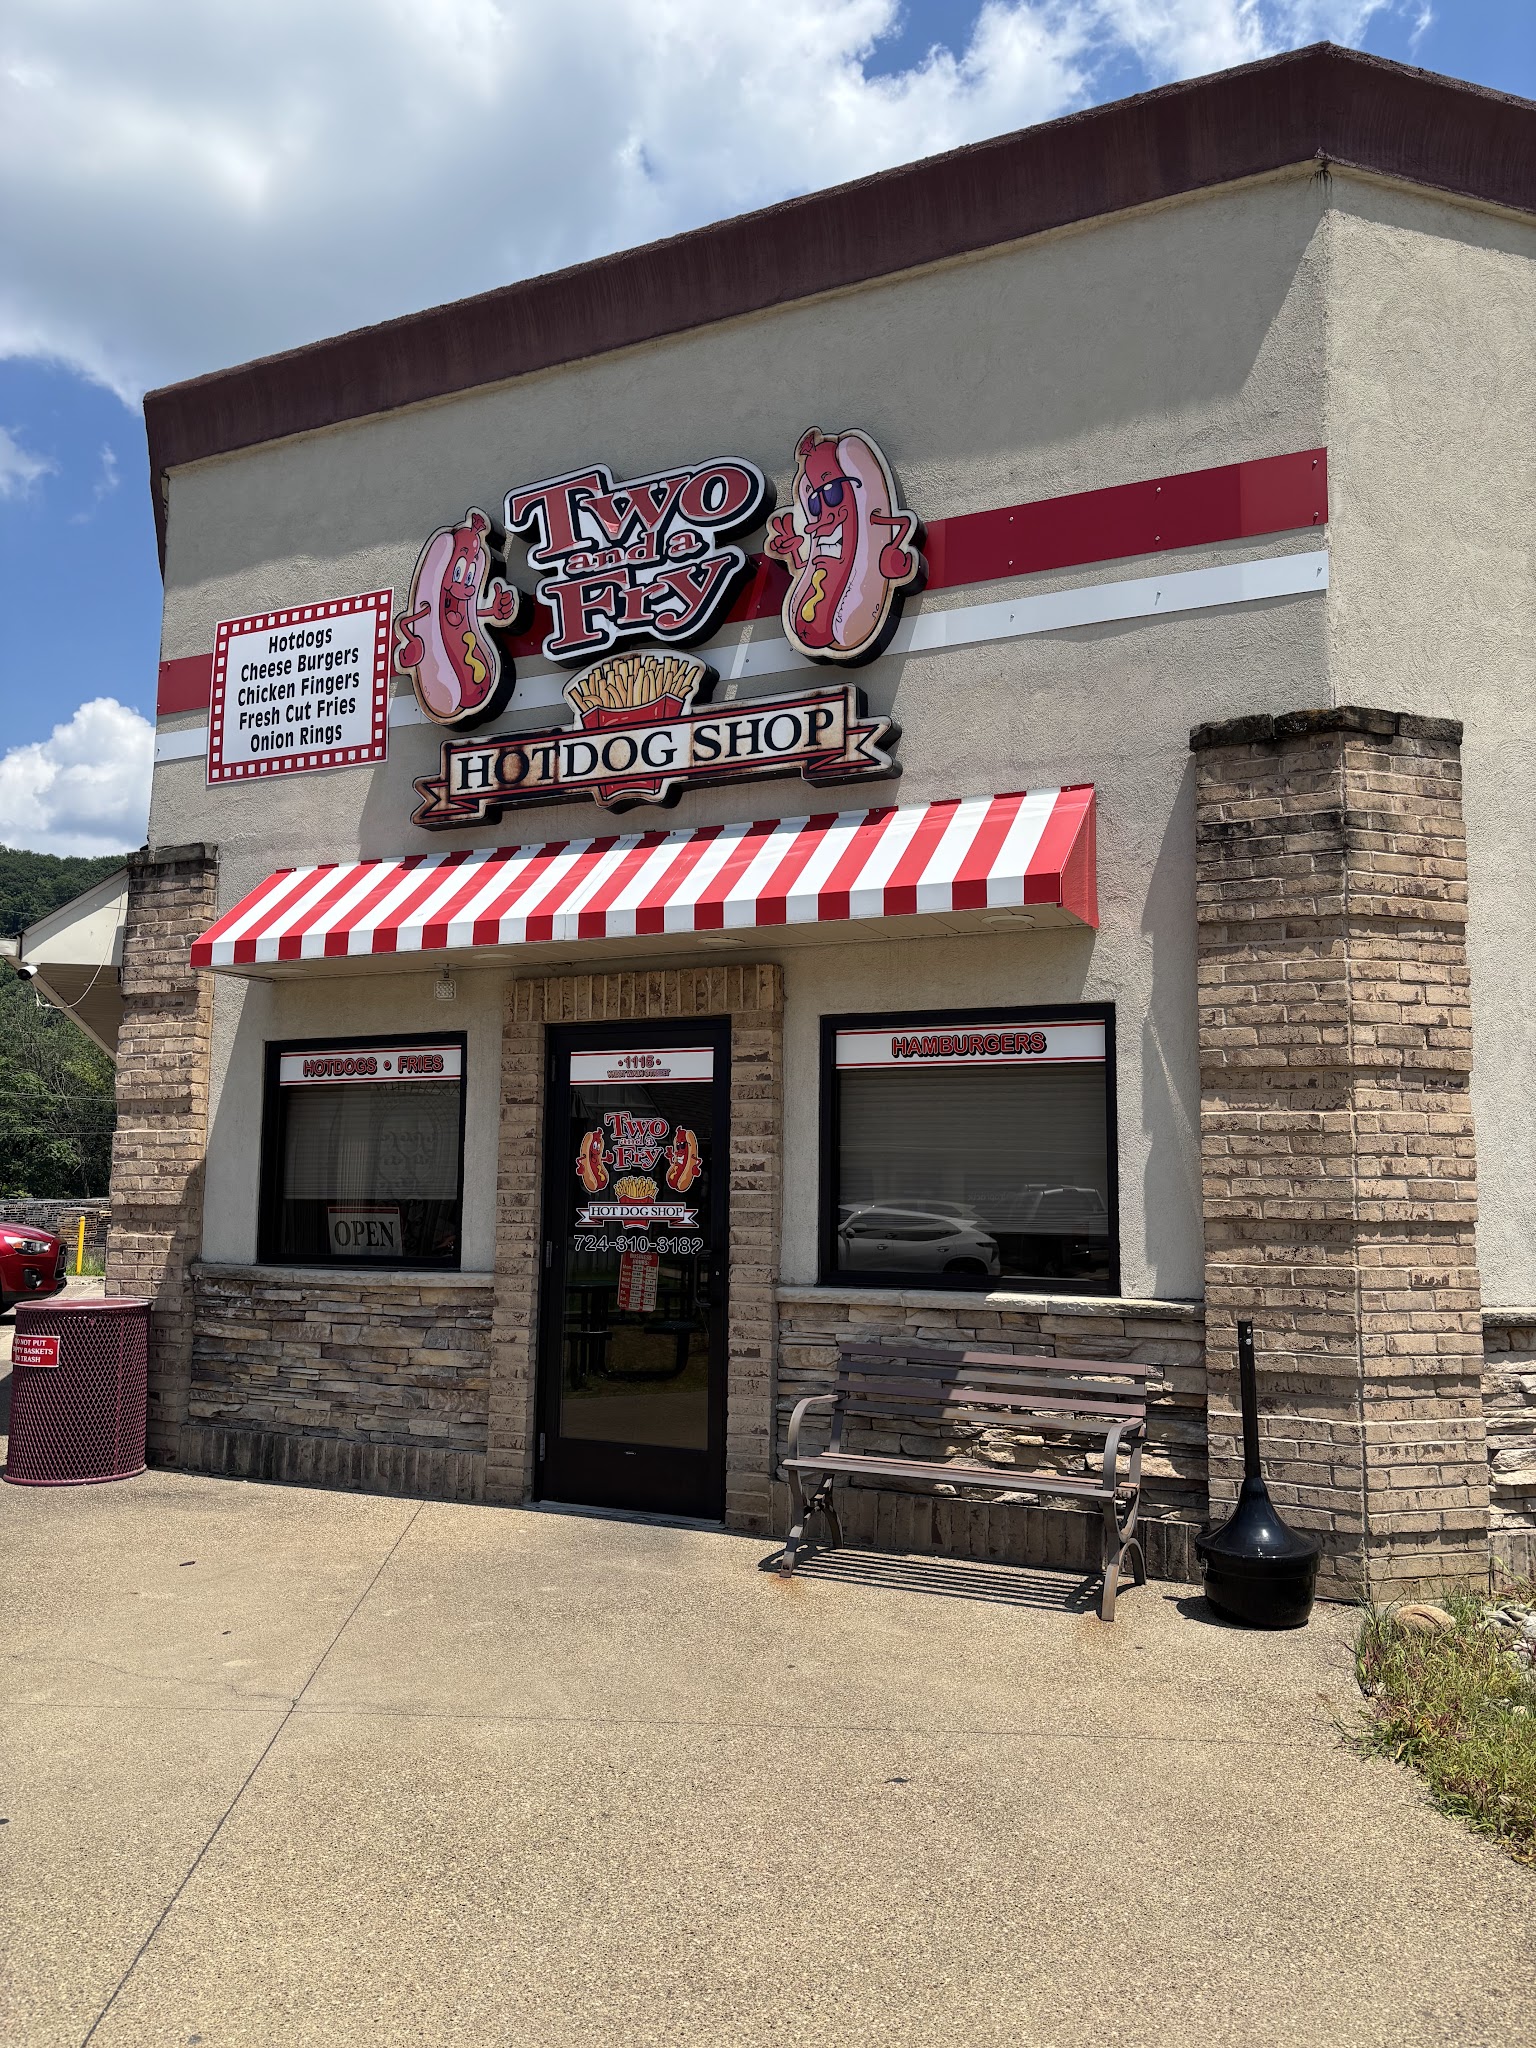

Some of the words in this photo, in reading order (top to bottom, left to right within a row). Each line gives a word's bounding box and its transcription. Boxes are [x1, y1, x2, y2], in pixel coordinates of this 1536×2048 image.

[511, 464, 752, 560] Two
[567, 530, 661, 574] and
[668, 528, 703, 559] a
[545, 553, 732, 651] Fry
[268, 627, 333, 654] Hotdogs
[240, 659, 293, 683] Cheese
[297, 646, 360, 673] Burgers
[237, 681, 296, 707] Chicken
[301, 671, 360, 697] Fingers
[239, 705, 281, 731] Fresh
[285, 700, 312, 724] Cut
[317, 695, 357, 719] Fries
[250, 725, 295, 753] Onion
[299, 723, 343, 748] Rings
[456, 730, 680, 791] HOTDOG
[692, 707, 835, 764] SHOP
[892, 1032, 1047, 1058] HAMBURGERS
[303, 1057, 378, 1077] HOTDOGS
[397, 1054, 444, 1074] FRIES
[604, 1112, 668, 1138] Two
[619, 1136, 645, 1147] and
[645, 1137, 656, 1147] a
[614, 1146, 664, 1170] Fry
[590, 1206, 618, 1217] HOT
[620, 1206, 649, 1217] DOG
[650, 1206, 683, 1217] SHOP
[334, 1220, 395, 1248] OPEN
[573, 1234, 704, 1255] 724-310-3182
[24, 1347, 53, 1355] BASKETS
